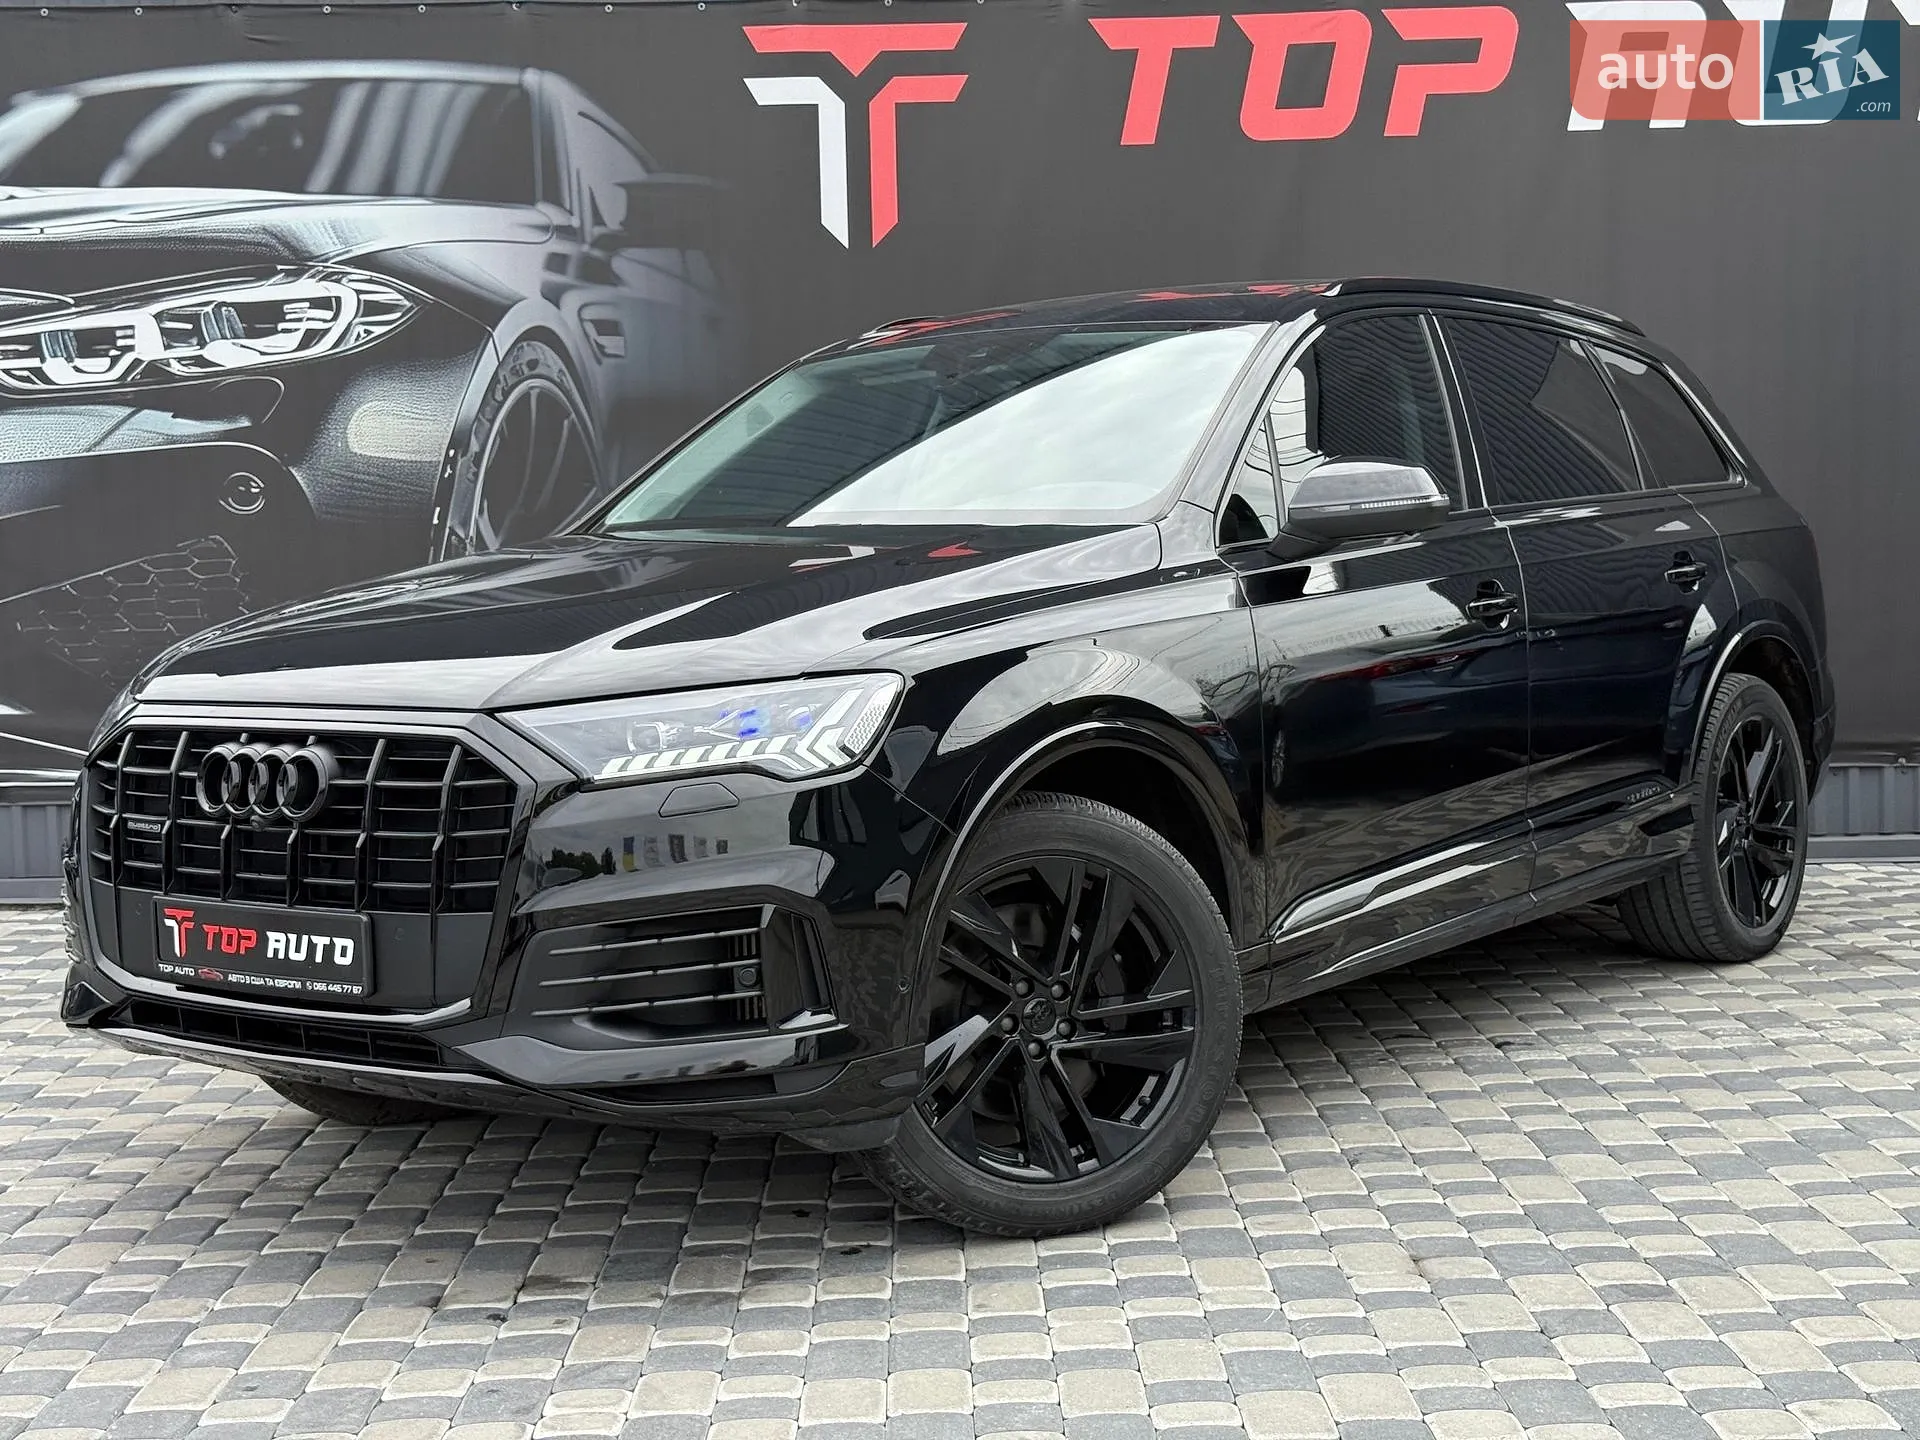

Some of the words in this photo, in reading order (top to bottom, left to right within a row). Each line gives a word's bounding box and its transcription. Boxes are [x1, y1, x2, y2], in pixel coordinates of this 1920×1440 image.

[1088, 5, 1519, 145] TOP
[202, 924, 257, 955] TOP
[266, 931, 355, 966] AUTO
[158, 963, 174, 973] TOP
[174, 966, 195, 976] AUTO
